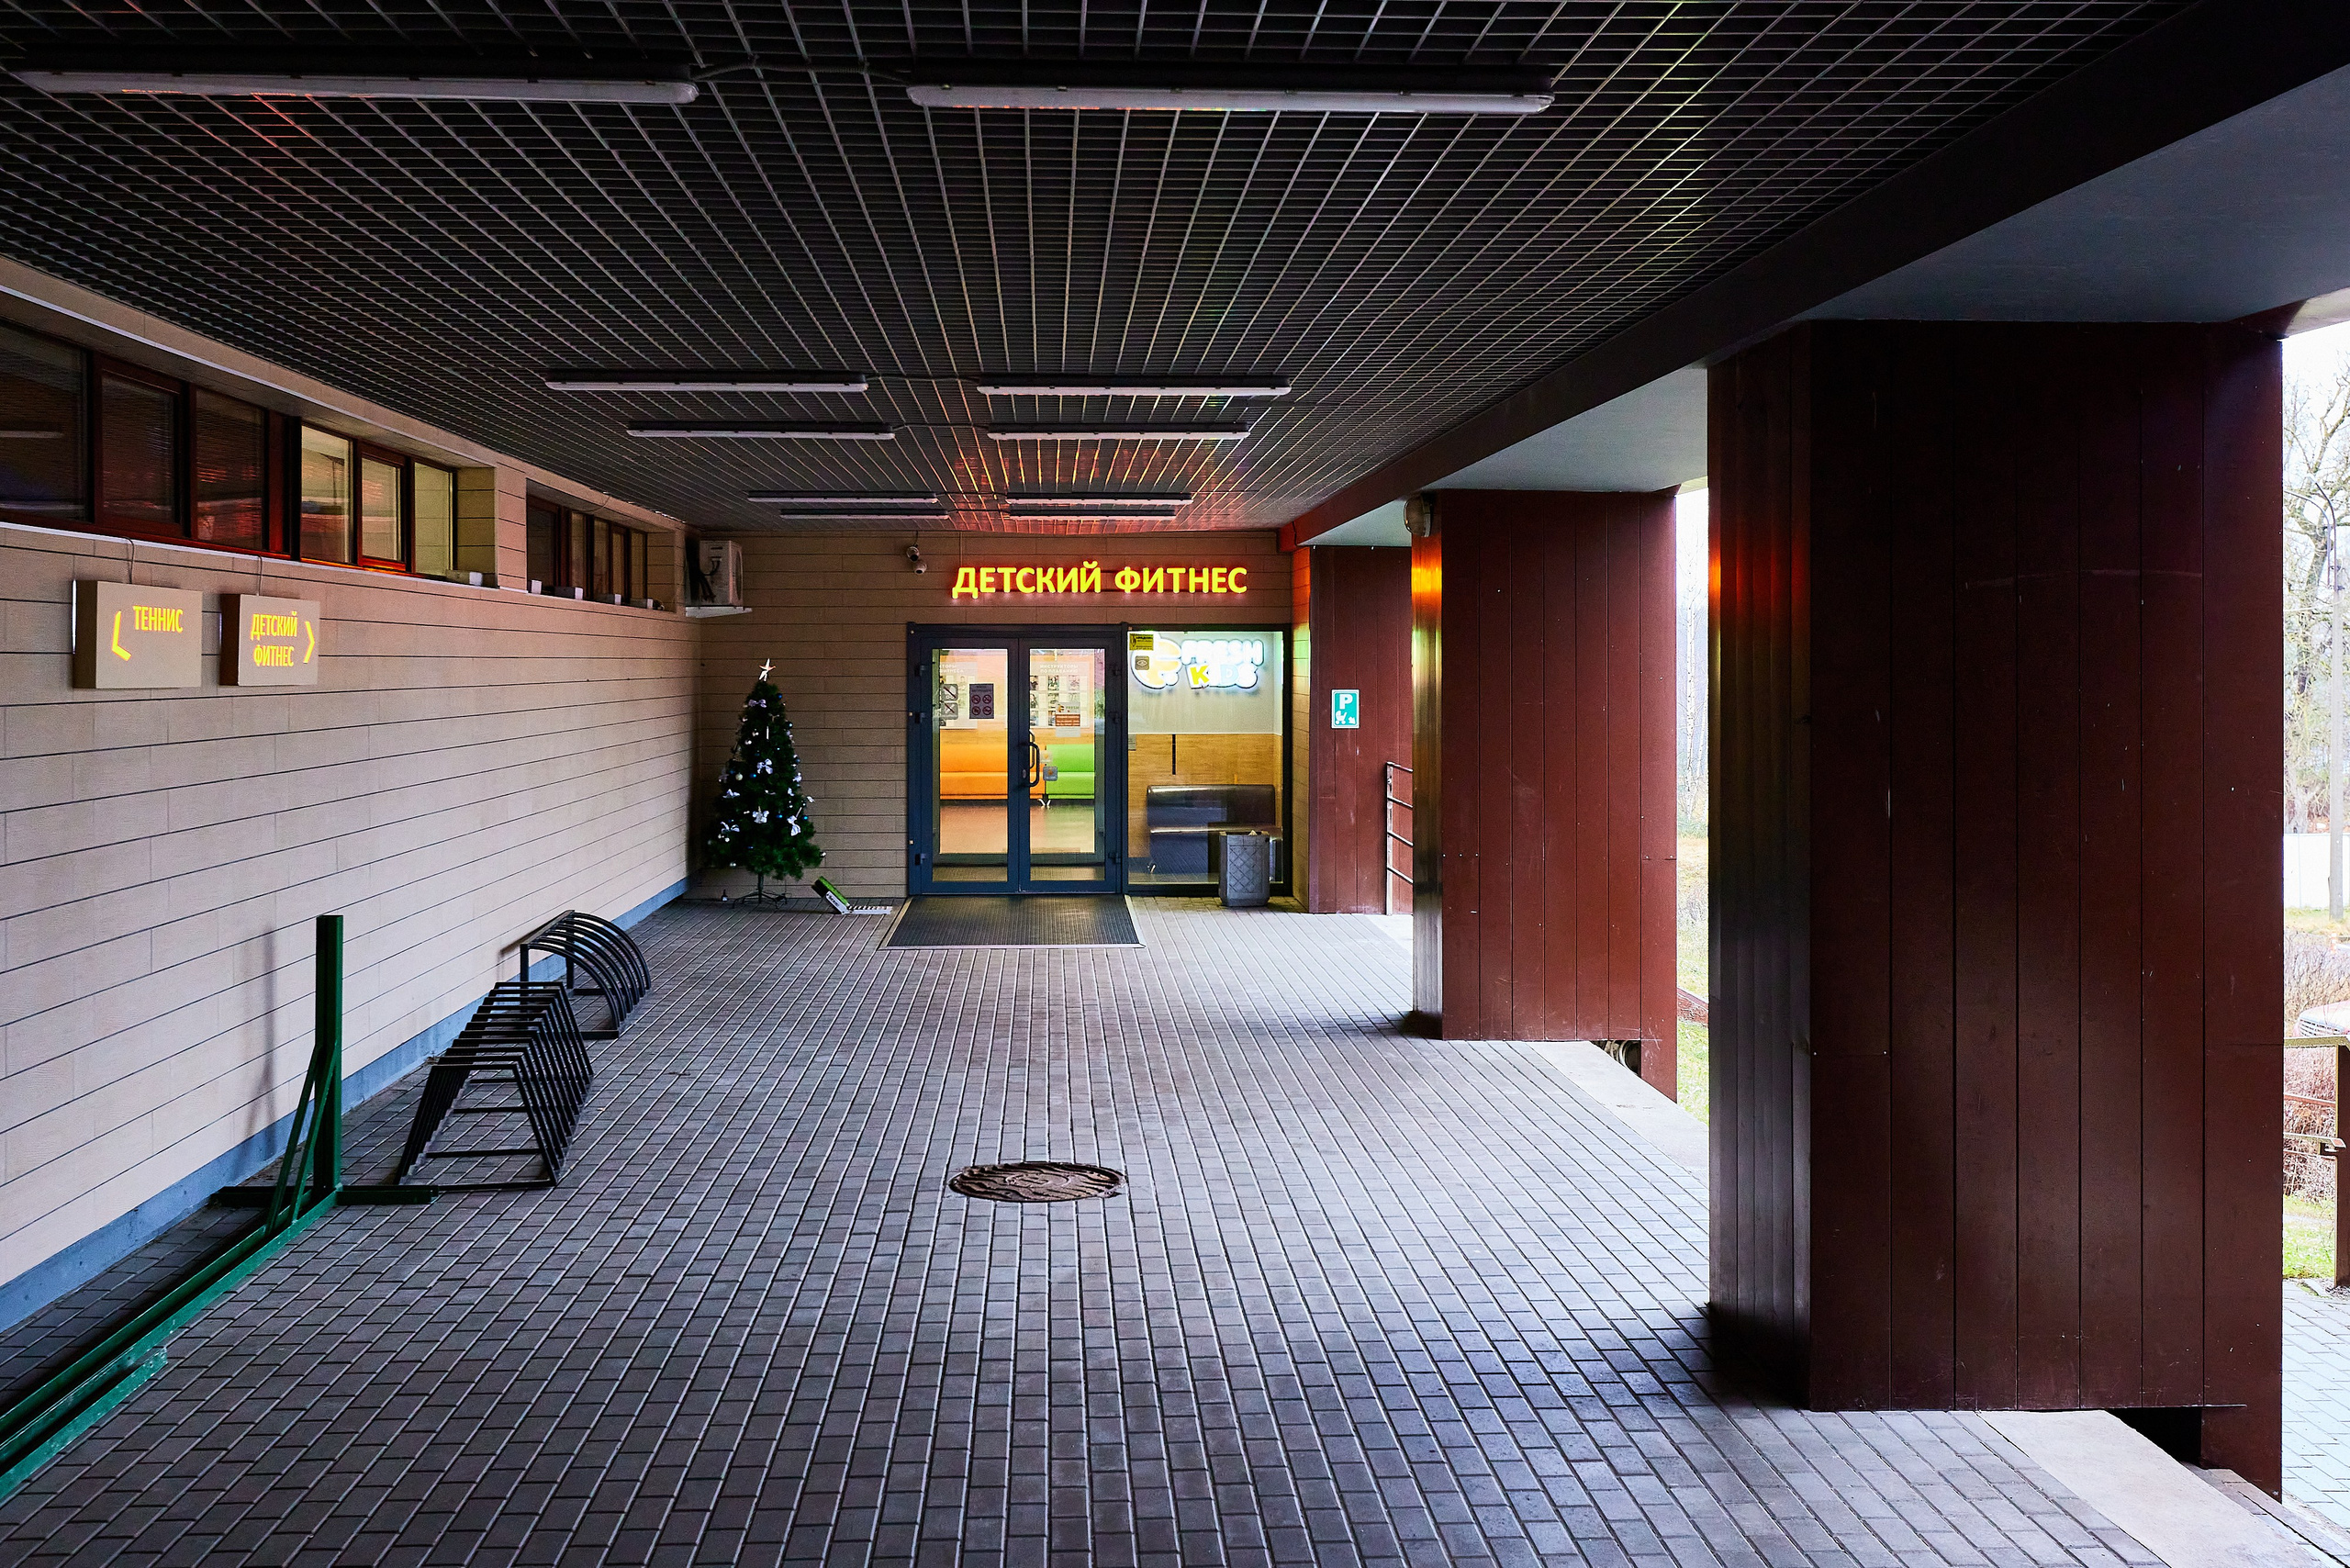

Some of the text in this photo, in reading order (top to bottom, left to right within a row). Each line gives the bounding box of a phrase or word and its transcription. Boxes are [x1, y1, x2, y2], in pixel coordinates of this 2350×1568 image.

[952, 560, 1248, 599] ДЕТСКИЙ ФИТНЕС
[132, 605, 184, 633] ТЕННИС
[250, 611, 297, 641] ДЕТСКИЙ
[252, 644, 295, 666] ФИТНЕС
[1182, 640, 1264, 666] FRESH
[1187, 663, 1258, 689] KIDS
[1339, 693, 1353, 710] P
